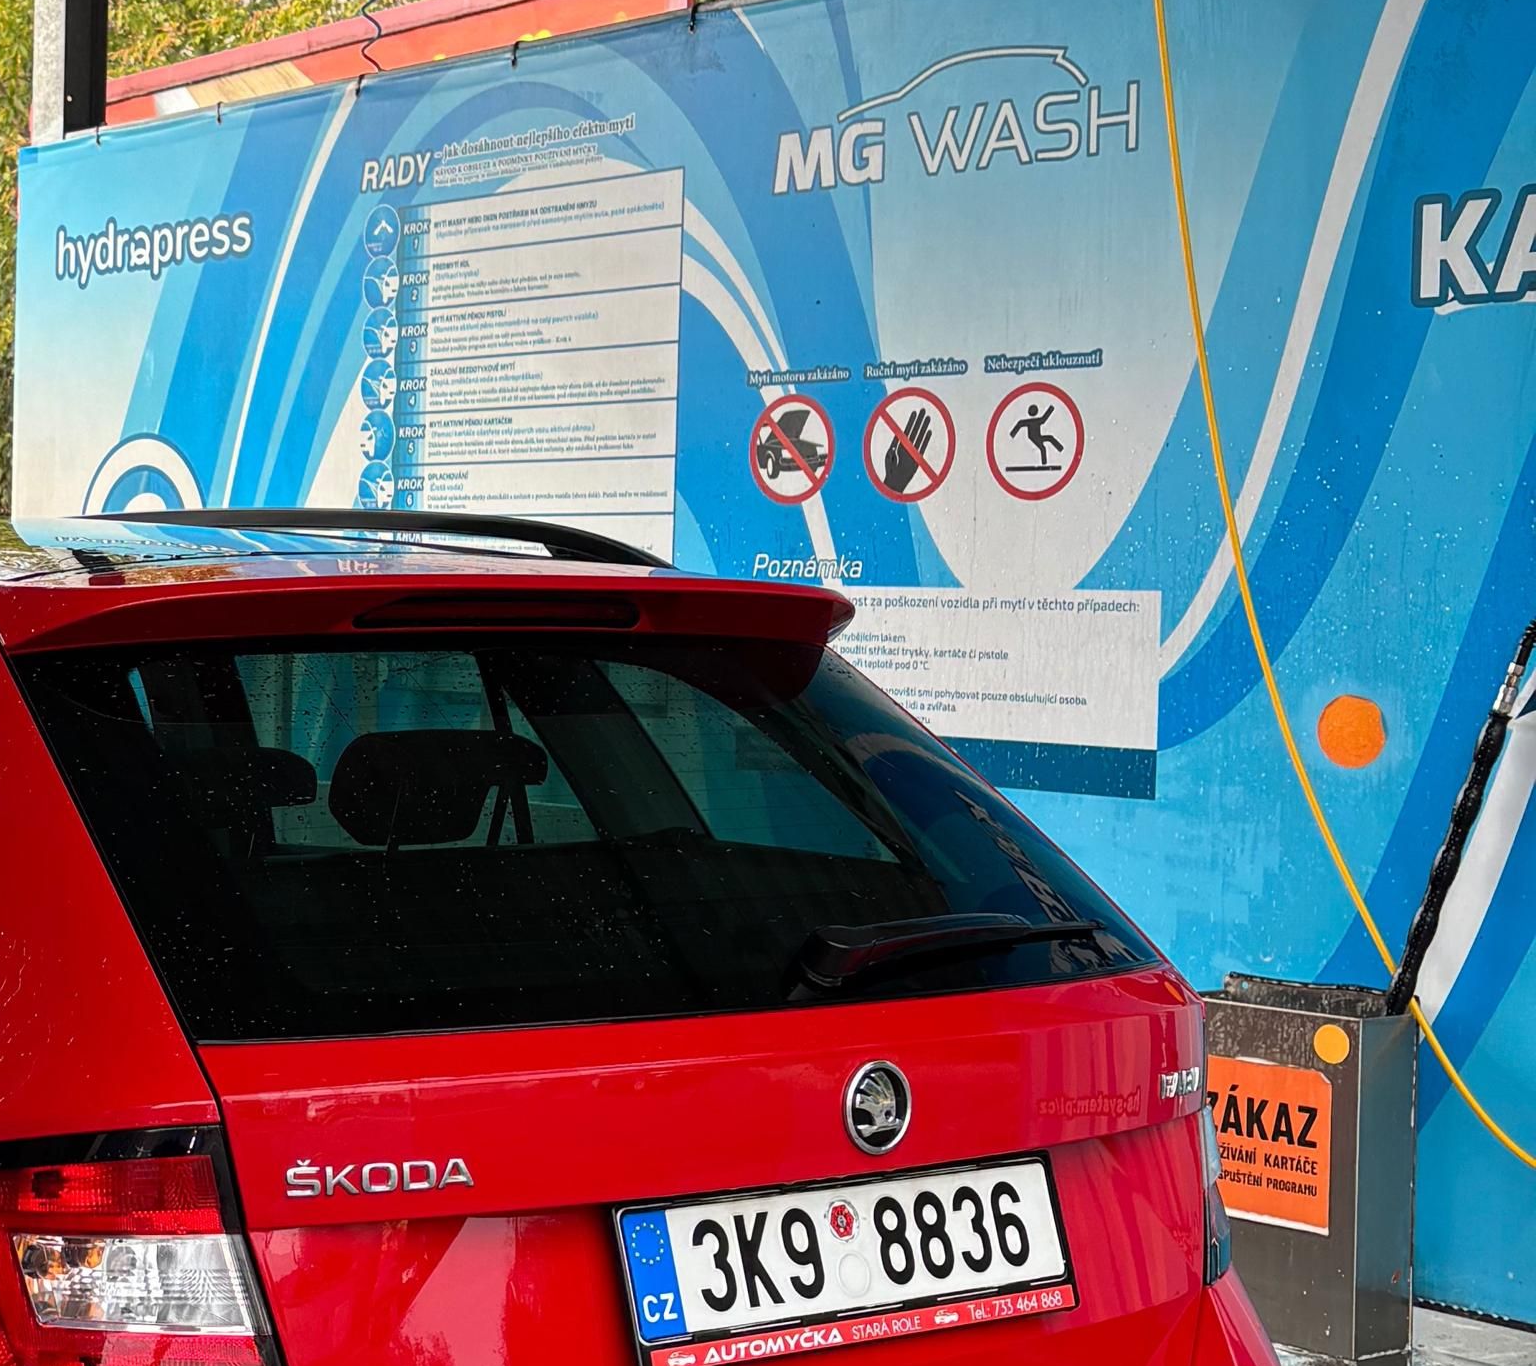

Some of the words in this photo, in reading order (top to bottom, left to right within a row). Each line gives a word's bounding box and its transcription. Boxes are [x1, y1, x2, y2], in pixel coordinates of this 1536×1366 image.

[461, 136, 513, 156] dosáhnout
[517, 127, 570, 148] nejlepšího
[573, 121, 605, 137] efektu
[609, 115, 634, 133] mytí
[772, 119, 885, 195] MG
[908, 80, 1140, 176] WASH
[361, 151, 431, 192] RADY
[403, 221, 430, 236] KROK
[56, 215, 254, 286] hydrapress
[402, 272, 429, 286] KROK
[411, 289, 418, 301] 2
[401, 325, 428, 337] KROK
[410, 340, 417, 353] 3
[866, 365, 894, 377] Ruční
[896, 364, 918, 380] mytí
[921, 359, 965, 374] zakázáno
[987, 354, 1040, 372] Nebezpečí
[1043, 349, 1100, 366] uklouznutí
[400, 378, 426, 390] KROK
[749, 372, 769, 386] Mytí
[772, 371, 805, 383] motoru
[807, 367, 849, 381] zakázáno
[408, 395, 415, 406] 4
[399, 427, 425, 439] KROK
[408, 442, 414, 453] 5
[398, 479, 424, 491] KROK
[406, 494, 412, 505] 6
[753, 553, 863, 578] Poznámka
[849, 596, 867, 607] ost
[870, 598, 882, 607] za
[884, 595, 938, 609] poškození
[940, 597, 979, 609] vozidla
[982, 597, 998, 611] při
[1001, 597, 1025, 613] mytí
[1028, 600, 1035, 609] v
[1037, 597, 1074, 611] těchto
[1077, 598, 1140, 614] případech:
[868, 645, 900, 656] stříkací
[934, 647, 967, 656] kartáče
[978, 649, 1008, 661] pistole
[895, 660, 910, 670] pod
[927, 701, 956, 712] zvířata
[935, 689, 979, 700] pohybovat
[981, 692, 1007, 702] pouze
[1009, 692, 1057, 705] obsluhující
[1059, 696, 1087, 706] osoba
[1219, 1142, 1257, 1164] ŽÍVÁNÍ
[1264, 1153, 1318, 1175] KARTÁČE
[286, 1158, 475, 1197] ŠKODA
[1266, 1177, 1317, 1197] PROGRAMU
[692, 1208, 825, 1312] 3K9
[873, 1181, 1030, 1285] 8836
[642, 1292, 678, 1324] CZ
[703, 1326, 844, 1365] AUTOMYČKA
[852, 1316, 891, 1340] STARÁ
[892, 1315, 922, 1333] ROLE
[993, 1300, 1013, 1317] 733
[1016, 1295, 1038, 1314] 464
[1042, 1291, 1063, 1309] 868
